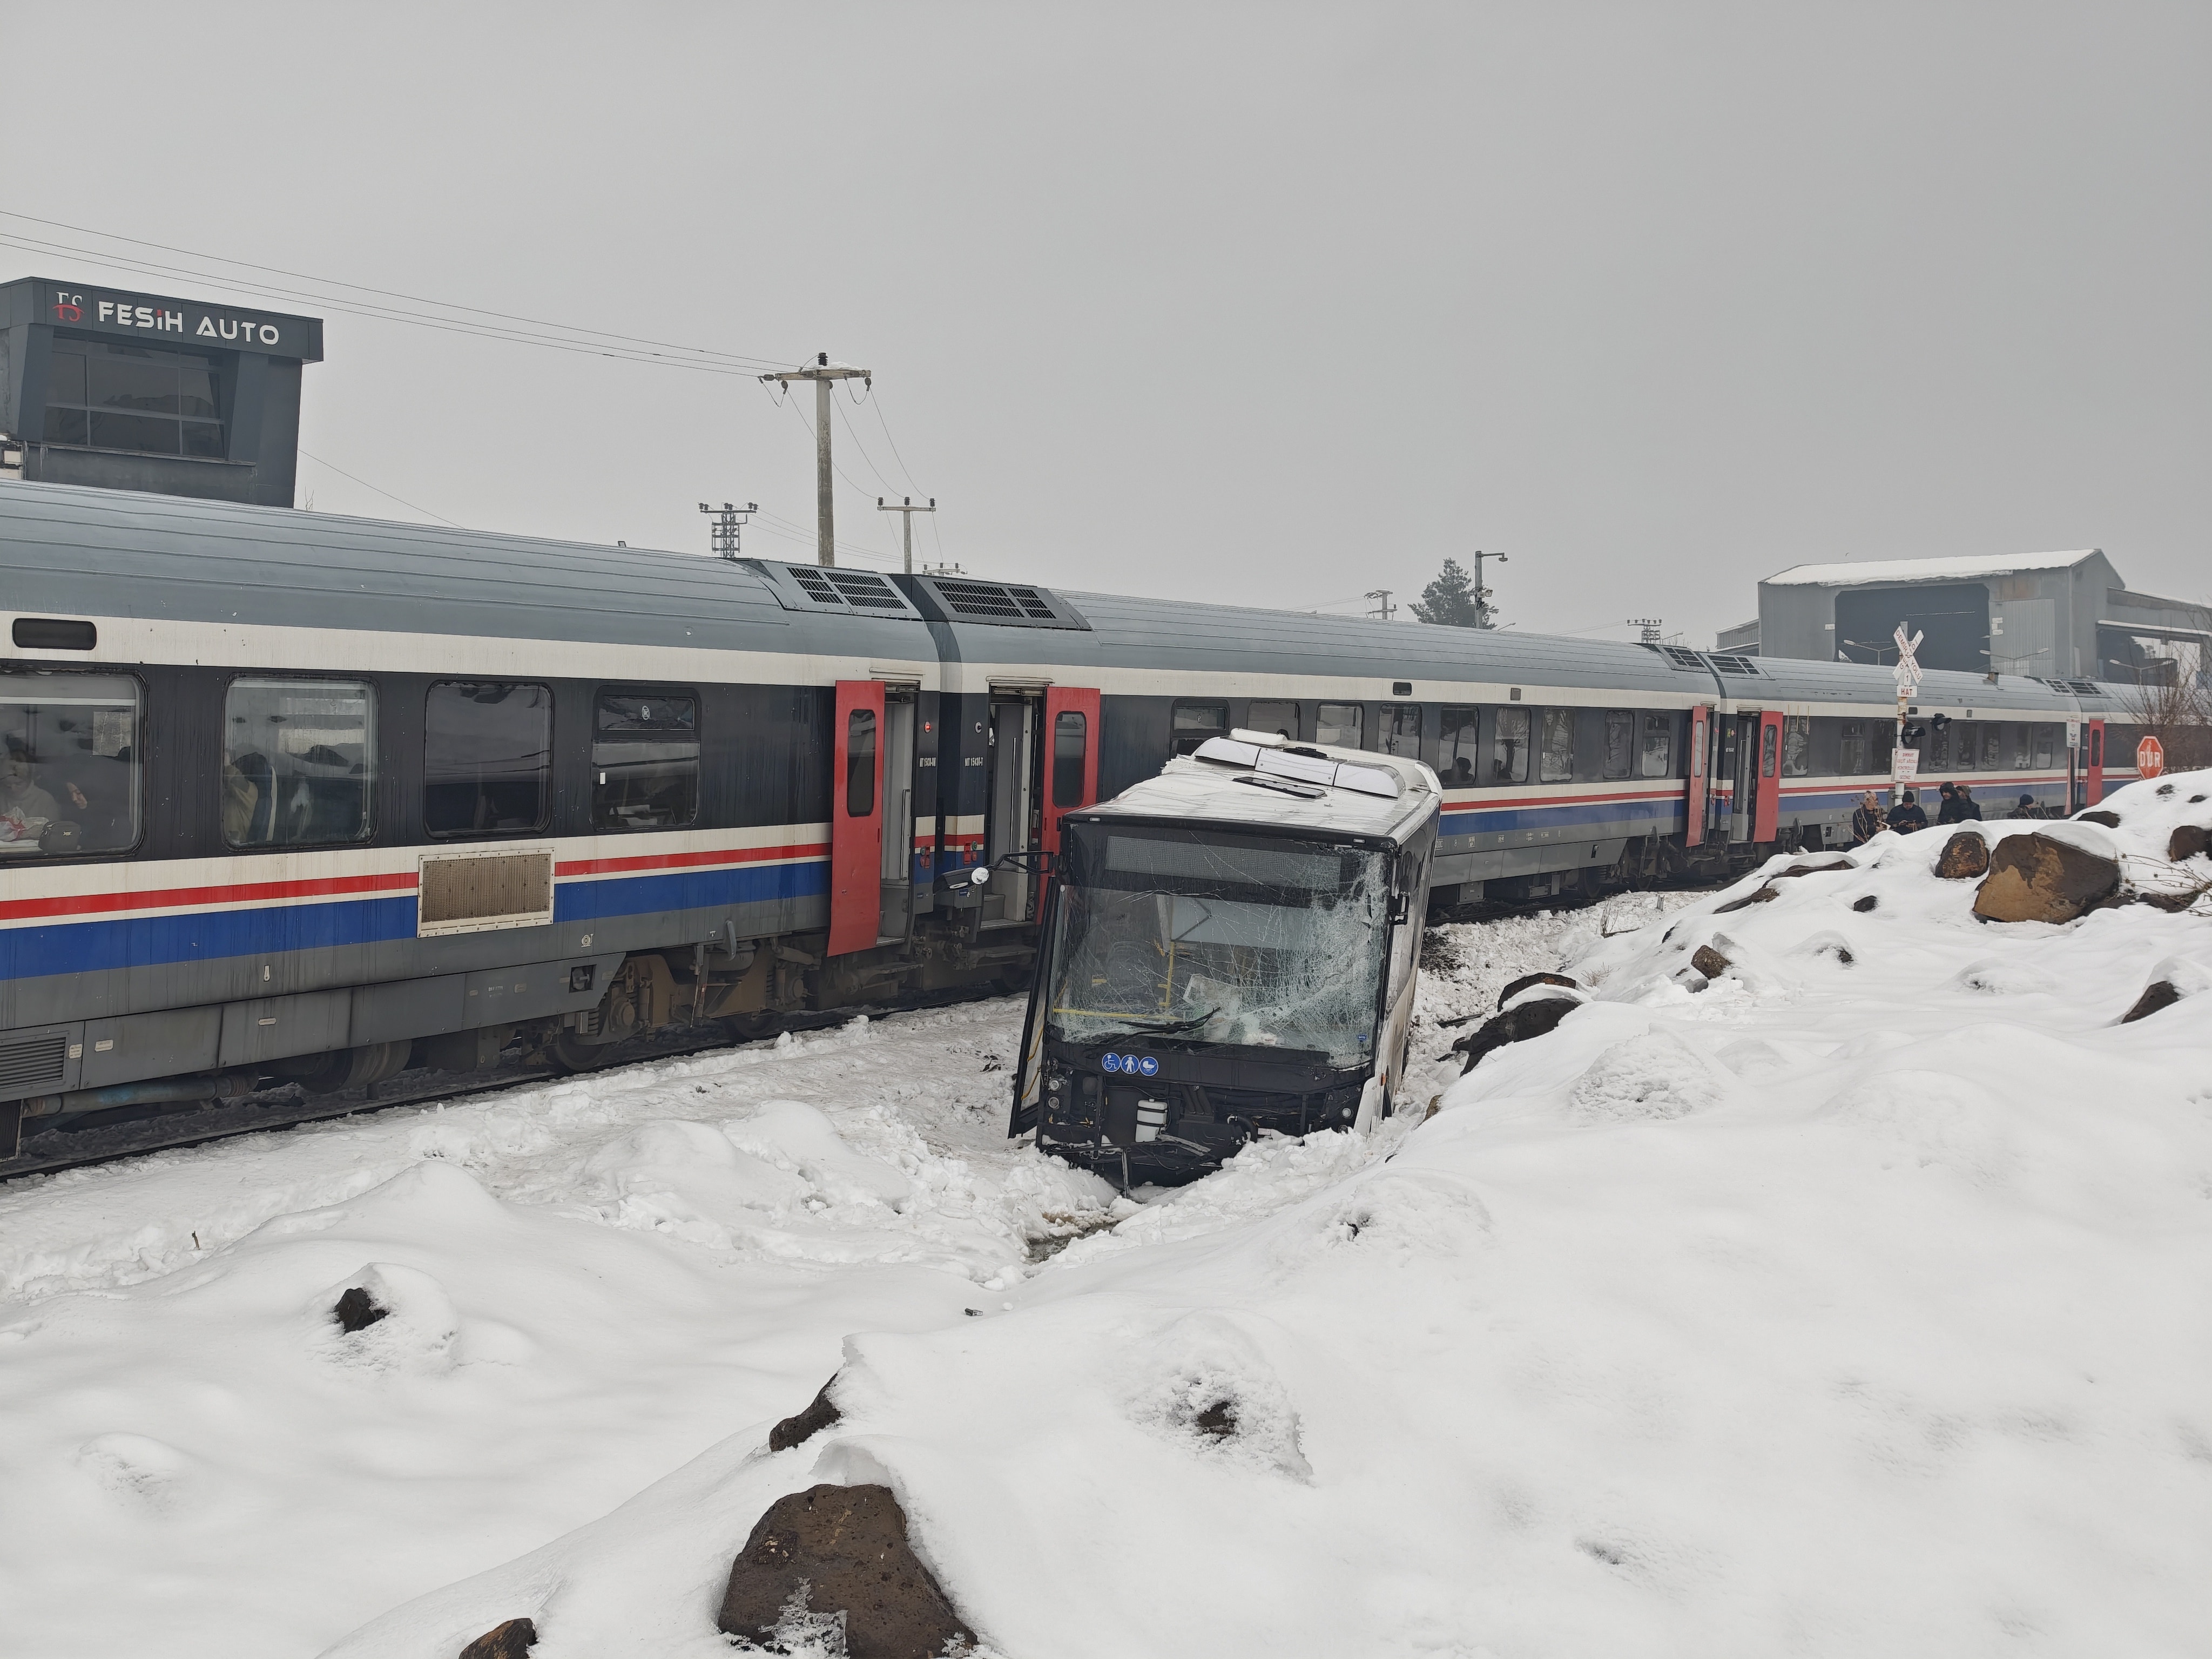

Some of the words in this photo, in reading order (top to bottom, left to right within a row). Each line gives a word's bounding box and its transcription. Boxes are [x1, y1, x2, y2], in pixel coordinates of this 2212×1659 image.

[195, 316, 280, 346] AUTO
[1901, 688, 1913, 696] HAT
[965, 757, 970, 767] MT
[2140, 751, 2161, 768] DUR
